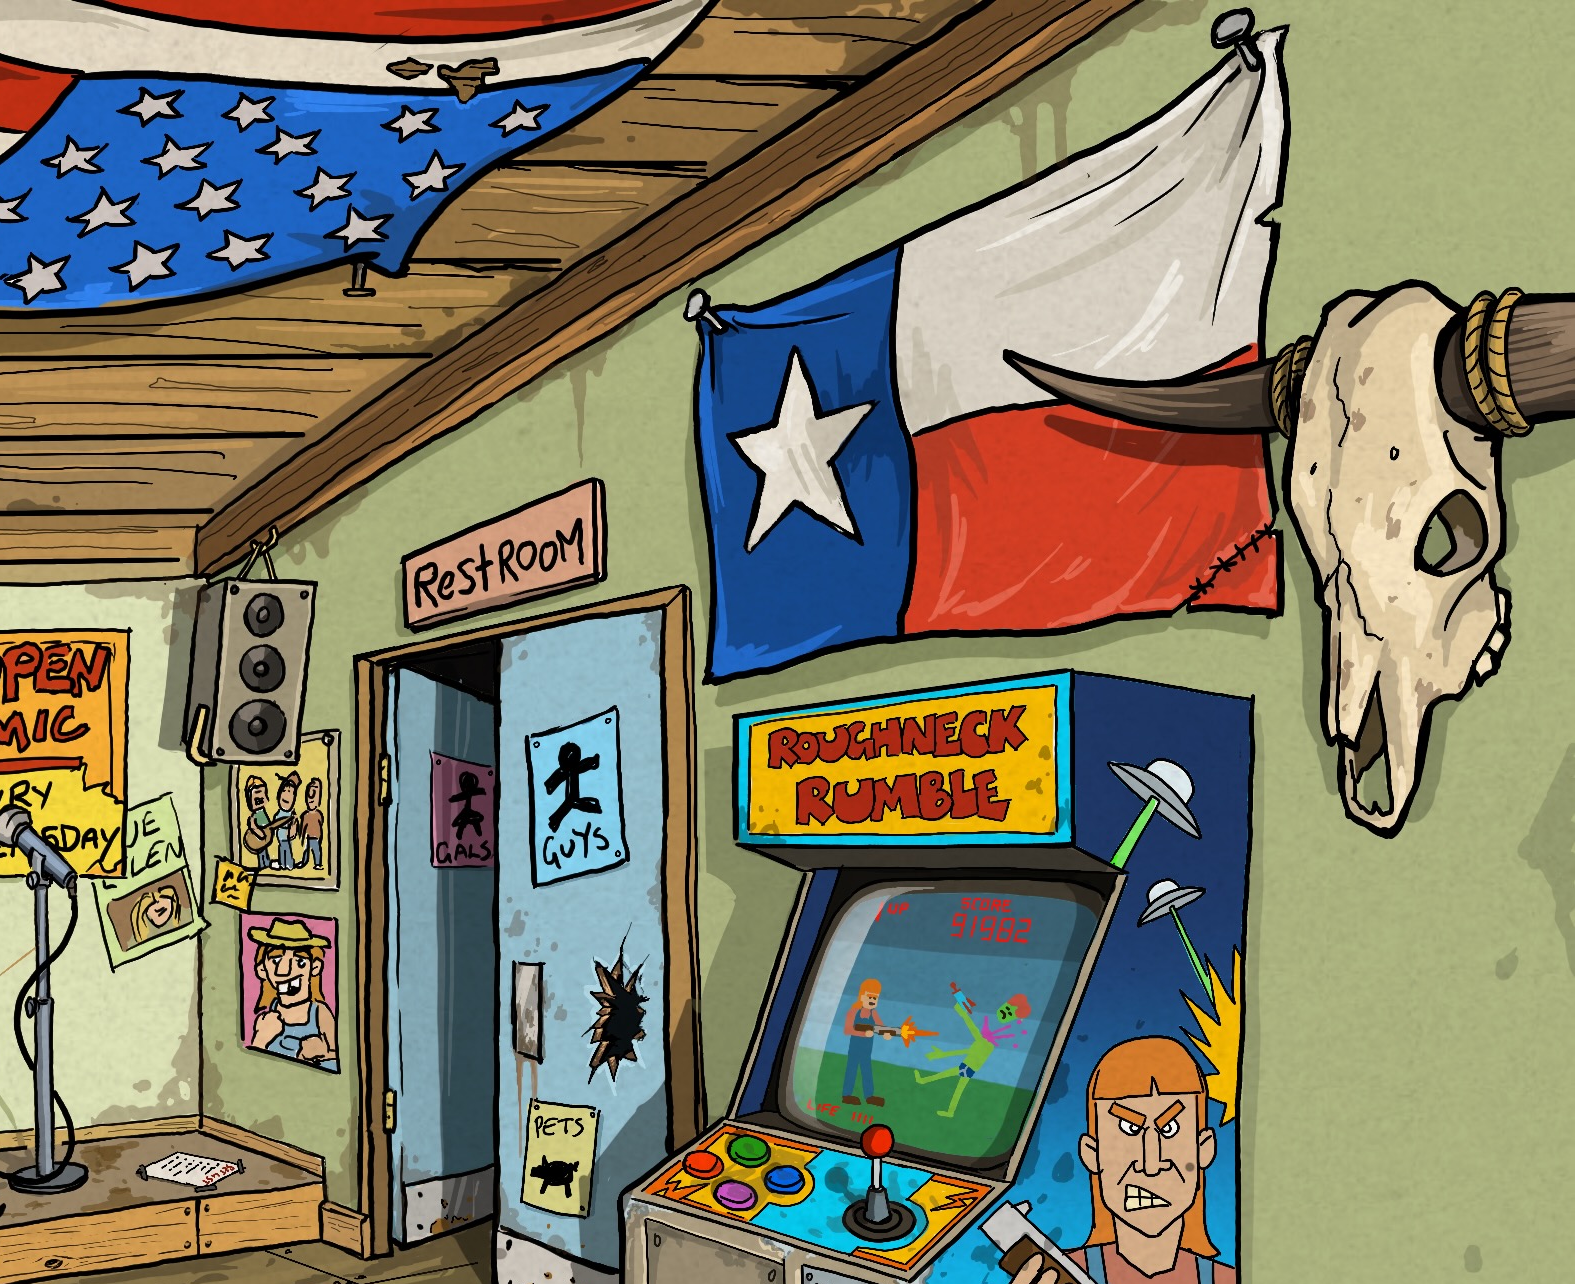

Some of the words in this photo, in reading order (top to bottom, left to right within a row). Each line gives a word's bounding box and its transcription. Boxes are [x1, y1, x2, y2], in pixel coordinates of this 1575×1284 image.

[768, 705, 1029, 769] ROUGHNECK
[795, 768, 1012, 826] RUMBLE
[436, 840, 491, 863] GALS
[543, 822, 610, 869] GUYS
[887, 901, 910, 915] UP
[961, 897, 1012, 912] SCORE
[951, 912, 1032, 944] 91982
[807, 1099, 841, 1116] LIFE
[534, 1116, 584, 1138] PETS
